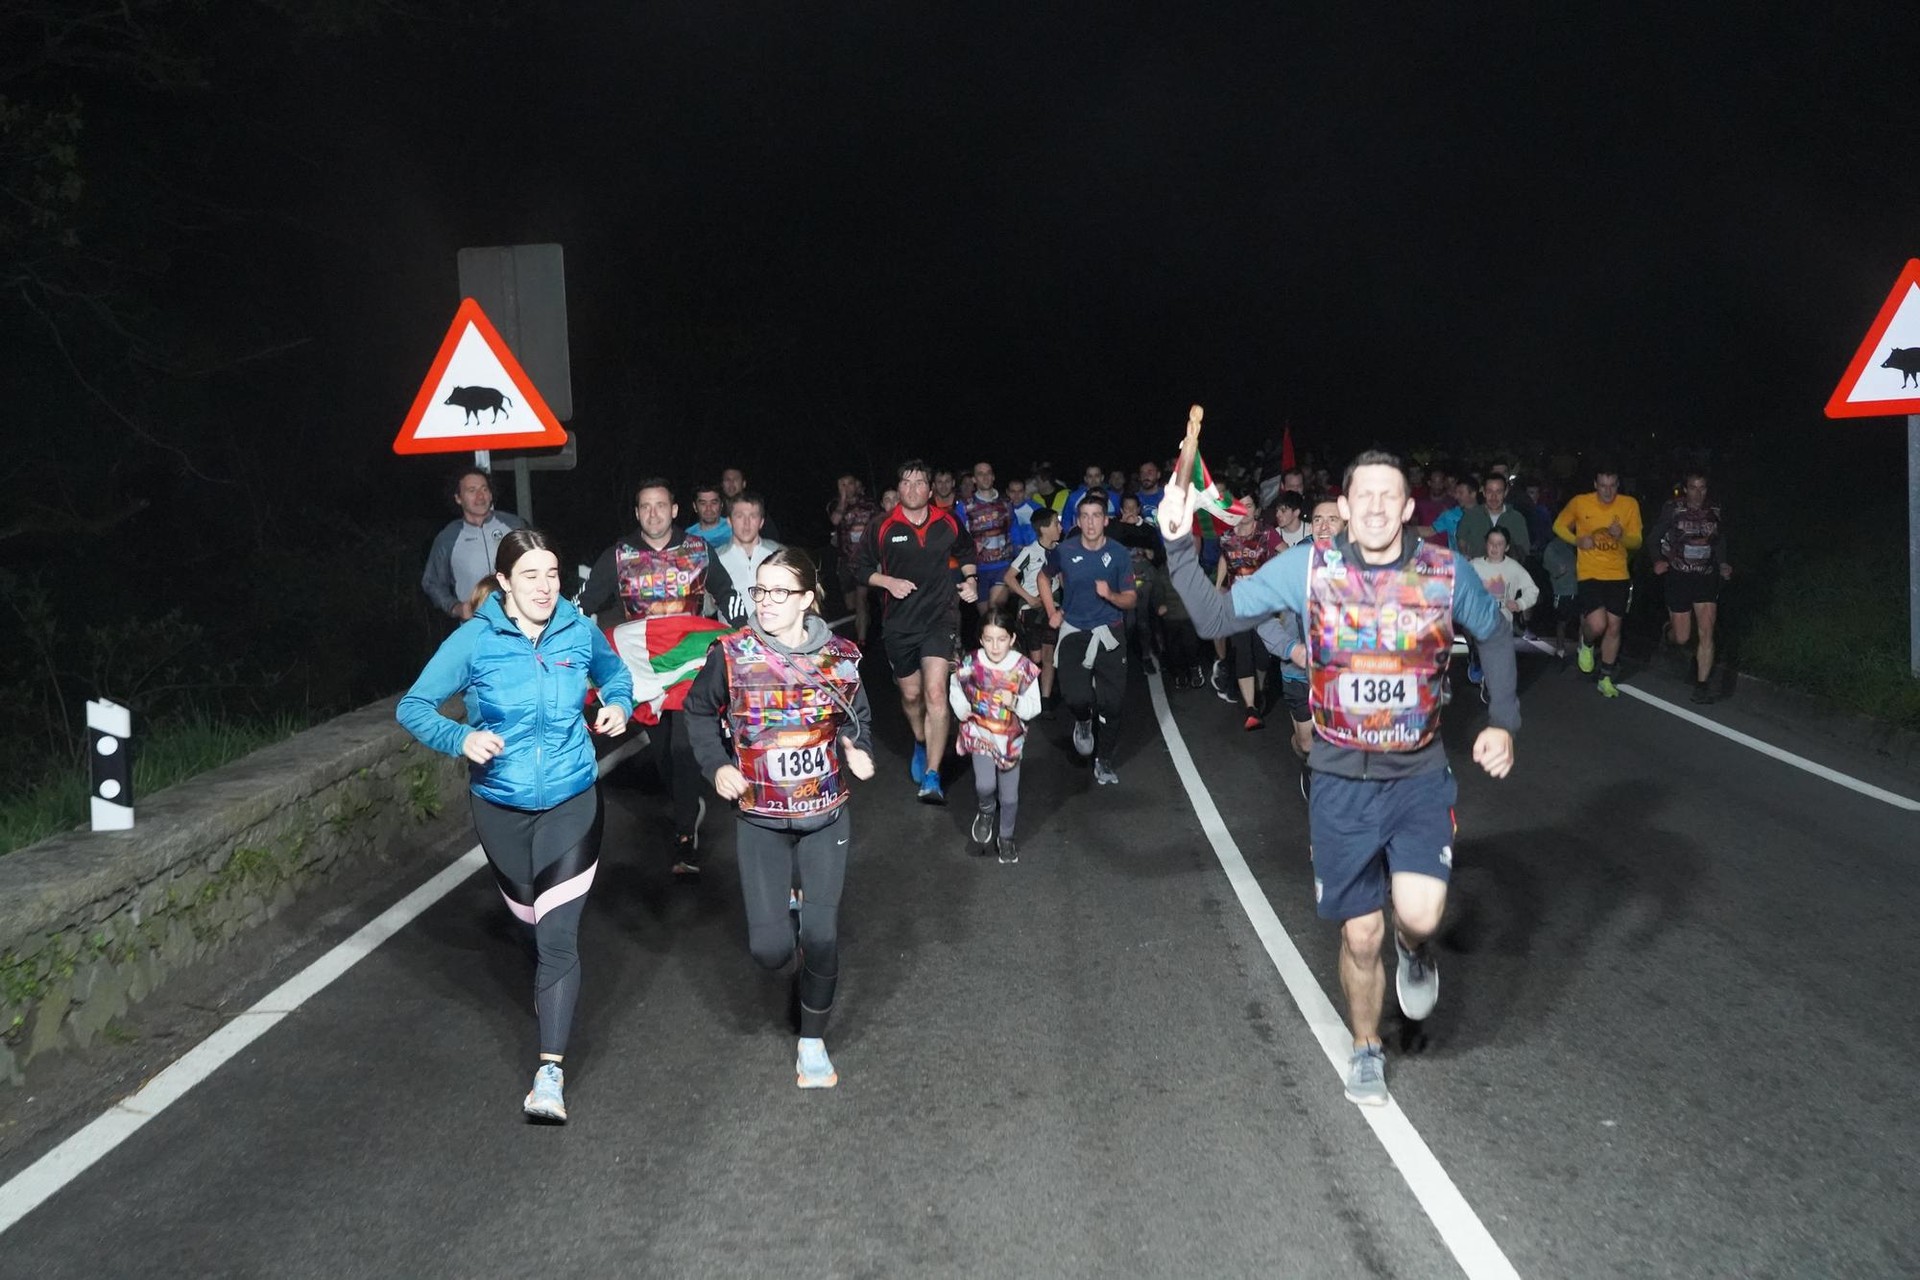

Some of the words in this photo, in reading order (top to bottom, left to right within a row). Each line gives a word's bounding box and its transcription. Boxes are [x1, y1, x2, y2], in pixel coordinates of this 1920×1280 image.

[1351, 678, 1406, 703] 1384
[1357, 722, 1420, 744] korrika
[778, 747, 825, 777] 1384
[792, 778, 820, 798] aek
